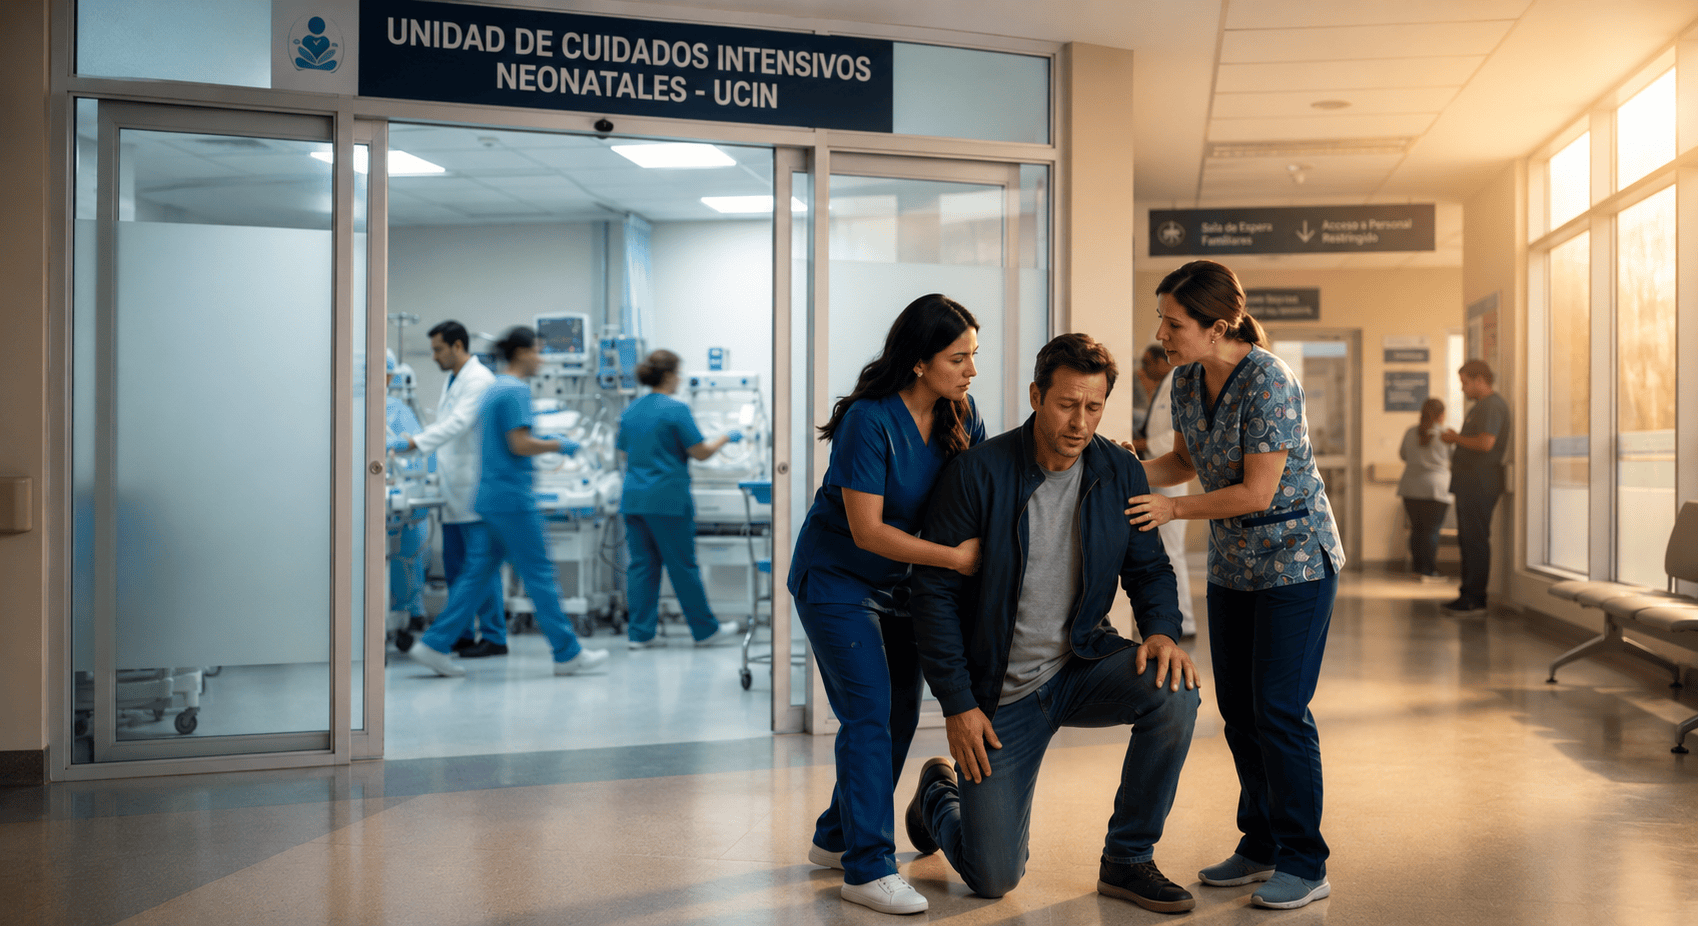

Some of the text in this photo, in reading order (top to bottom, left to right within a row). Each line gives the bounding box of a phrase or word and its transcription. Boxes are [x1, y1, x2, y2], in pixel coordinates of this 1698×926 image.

[387, 17, 871, 82] UNIDAD DE CUIDADOS INTENSIVOS
[497, 62, 687, 103] NEONATALES
[714, 79, 778, 109] UCIN
[1201, 221, 1223, 233] Sala
[1224, 221, 1238, 233] de
[1322, 219, 1359, 231] Acceso
[1368, 218, 1413, 230] Personal
[1201, 234, 1253, 247] Familiares
[1321, 232, 1379, 246] Restringido
